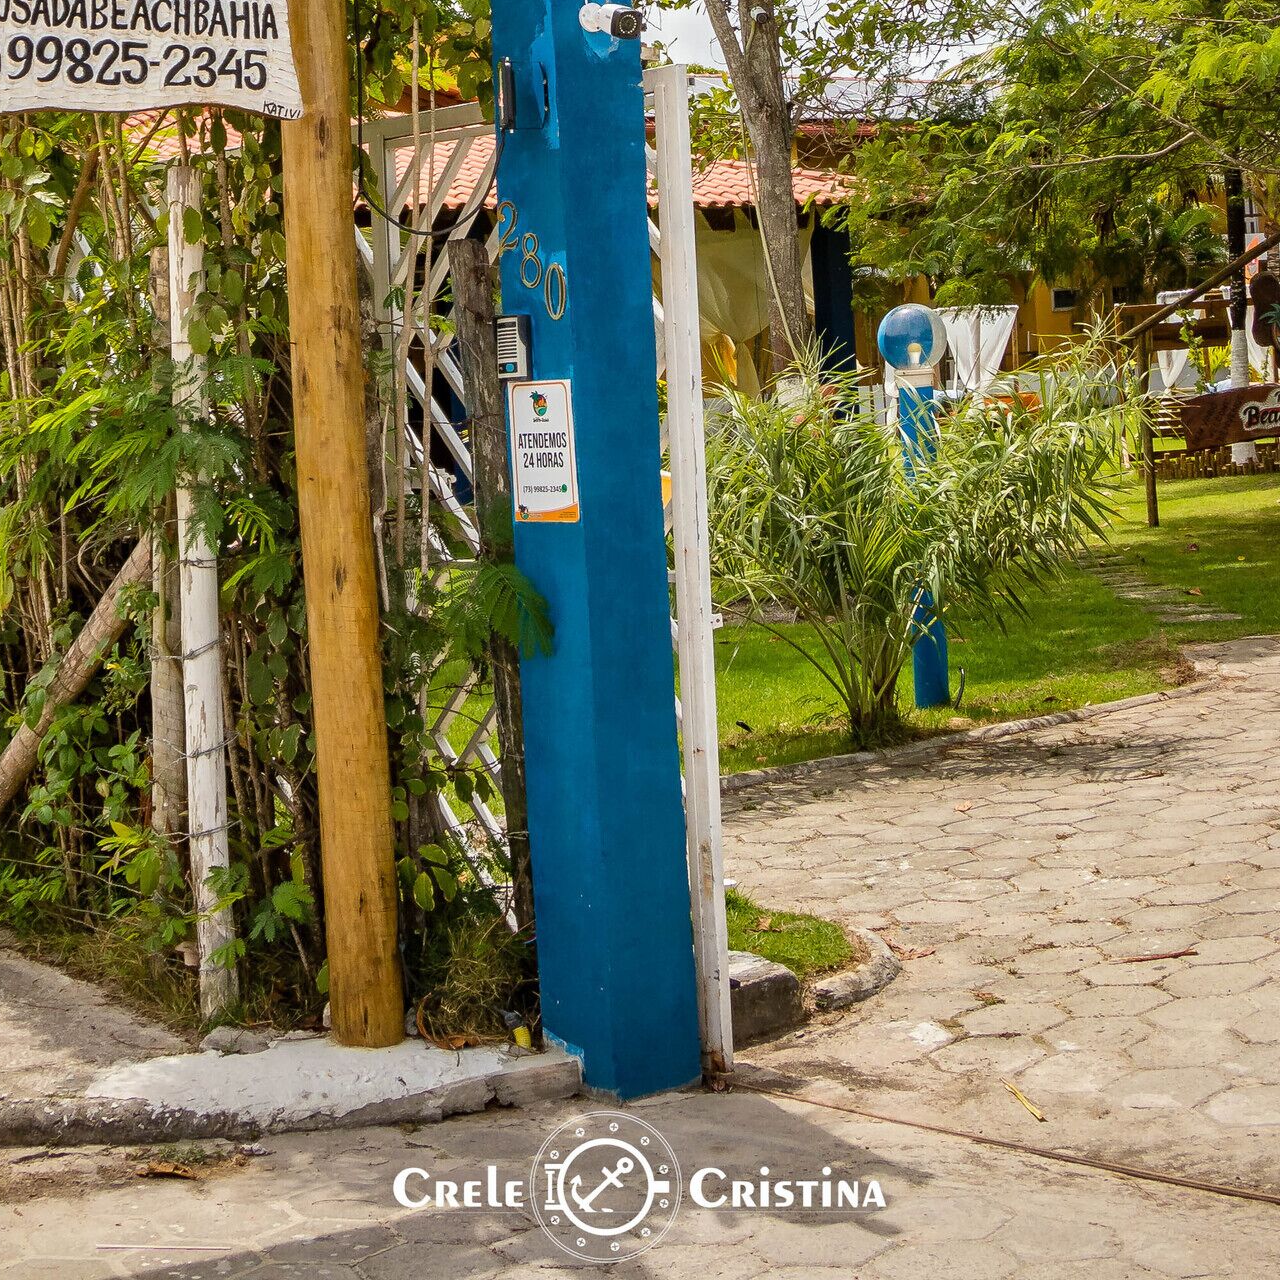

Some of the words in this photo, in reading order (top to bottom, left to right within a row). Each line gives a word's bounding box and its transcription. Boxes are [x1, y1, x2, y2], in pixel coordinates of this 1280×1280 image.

[497, 200, 567, 320] 280
[518, 432, 567, 449] ATENDEMOS
[523, 452, 535, 468] 24
[536, 451, 564, 468] HORAS
